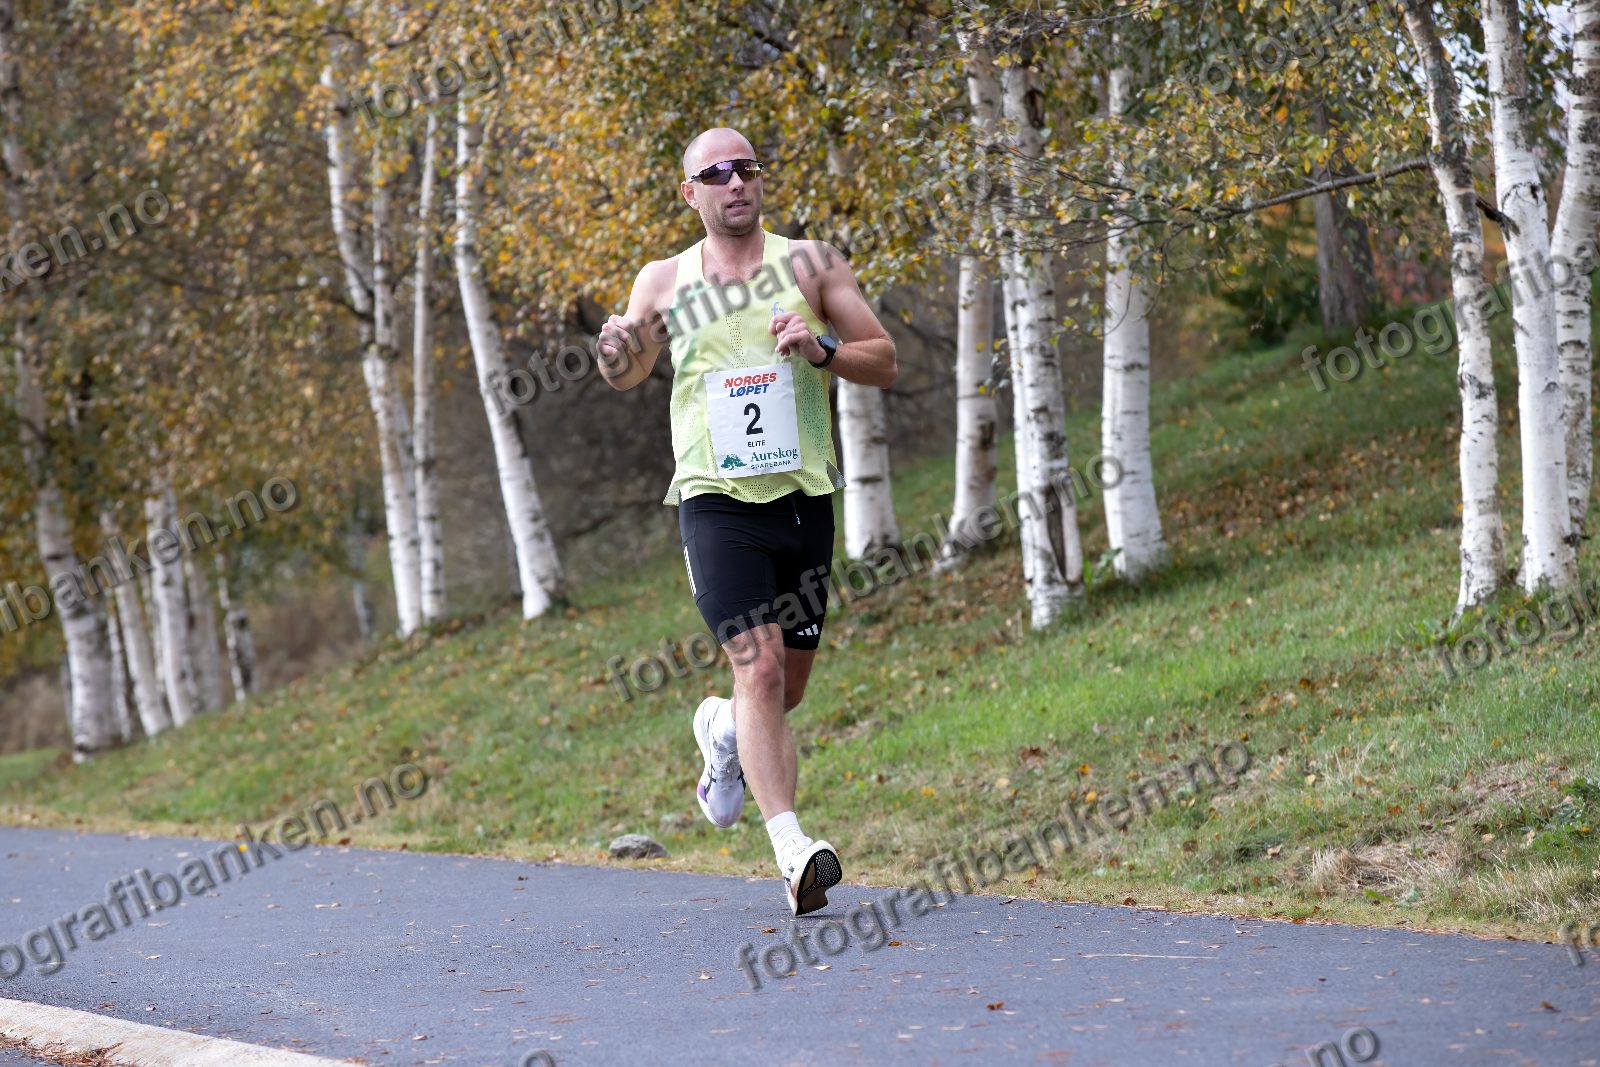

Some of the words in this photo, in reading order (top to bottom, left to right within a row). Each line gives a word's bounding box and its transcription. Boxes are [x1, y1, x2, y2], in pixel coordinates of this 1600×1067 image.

[723, 373, 777, 388] NORGES
[729, 383, 770, 398] LØPET
[743, 403, 763, 435] 2
[747, 440, 766, 448] ELITE
[750, 447, 799, 462] Aurskog
